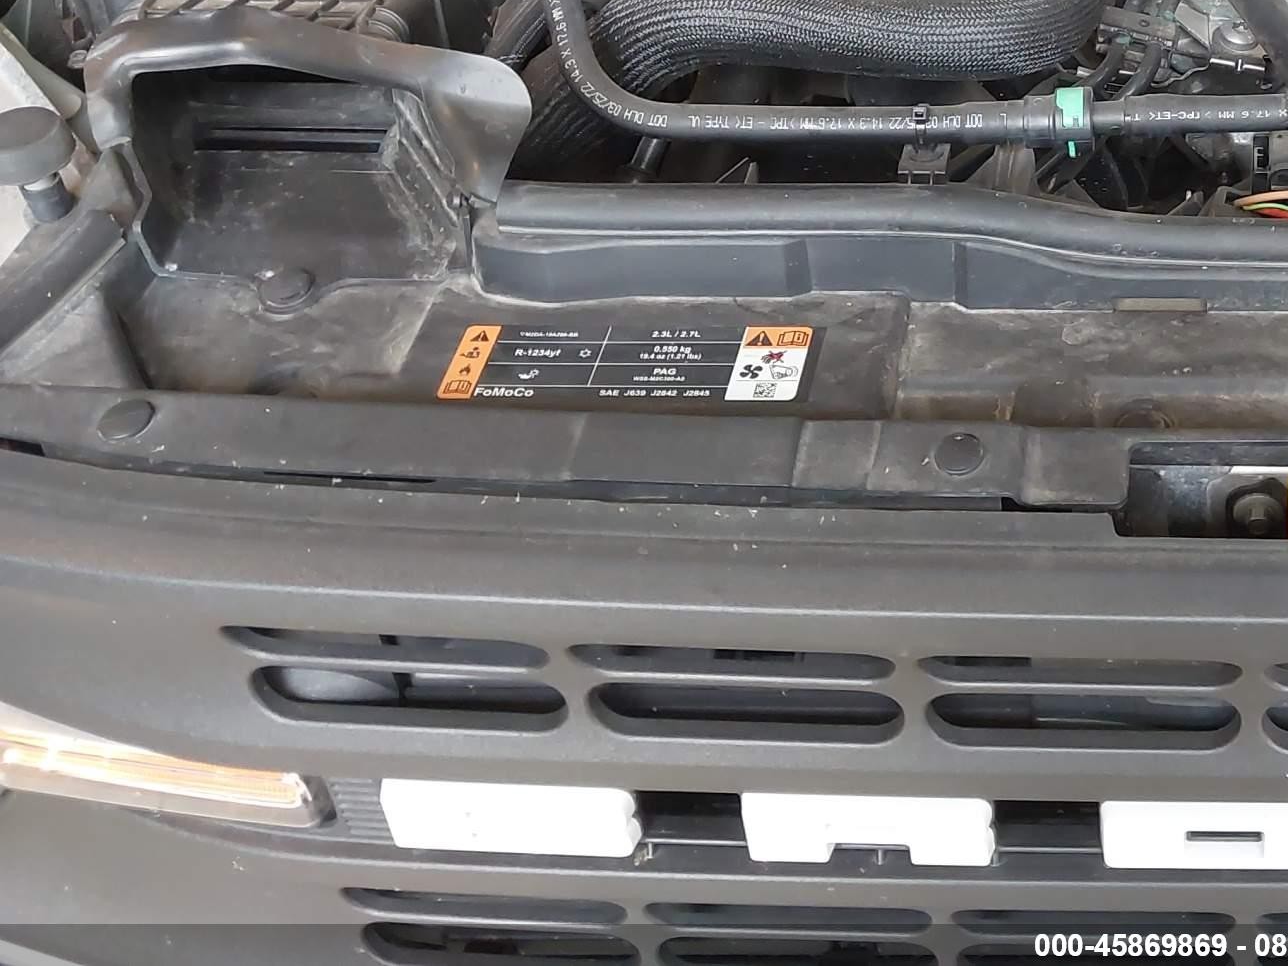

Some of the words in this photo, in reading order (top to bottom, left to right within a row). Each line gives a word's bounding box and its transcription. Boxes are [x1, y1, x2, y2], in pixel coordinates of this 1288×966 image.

[560, 48, 572, 59] X
[704, 115, 730, 129] TYPE
[847, 117, 856, 129] X
[652, 330, 673, 338] 2.3L
[680, 330, 701, 338] 2.7L
[514, 348, 561, 358] R-1234yf
[679, 345, 692, 355] kg
[653, 367, 677, 375] PAG
[473, 387, 535, 397] FoMoCo
[599, 389, 620, 397] SAE
[623, 389, 647, 397] J639
